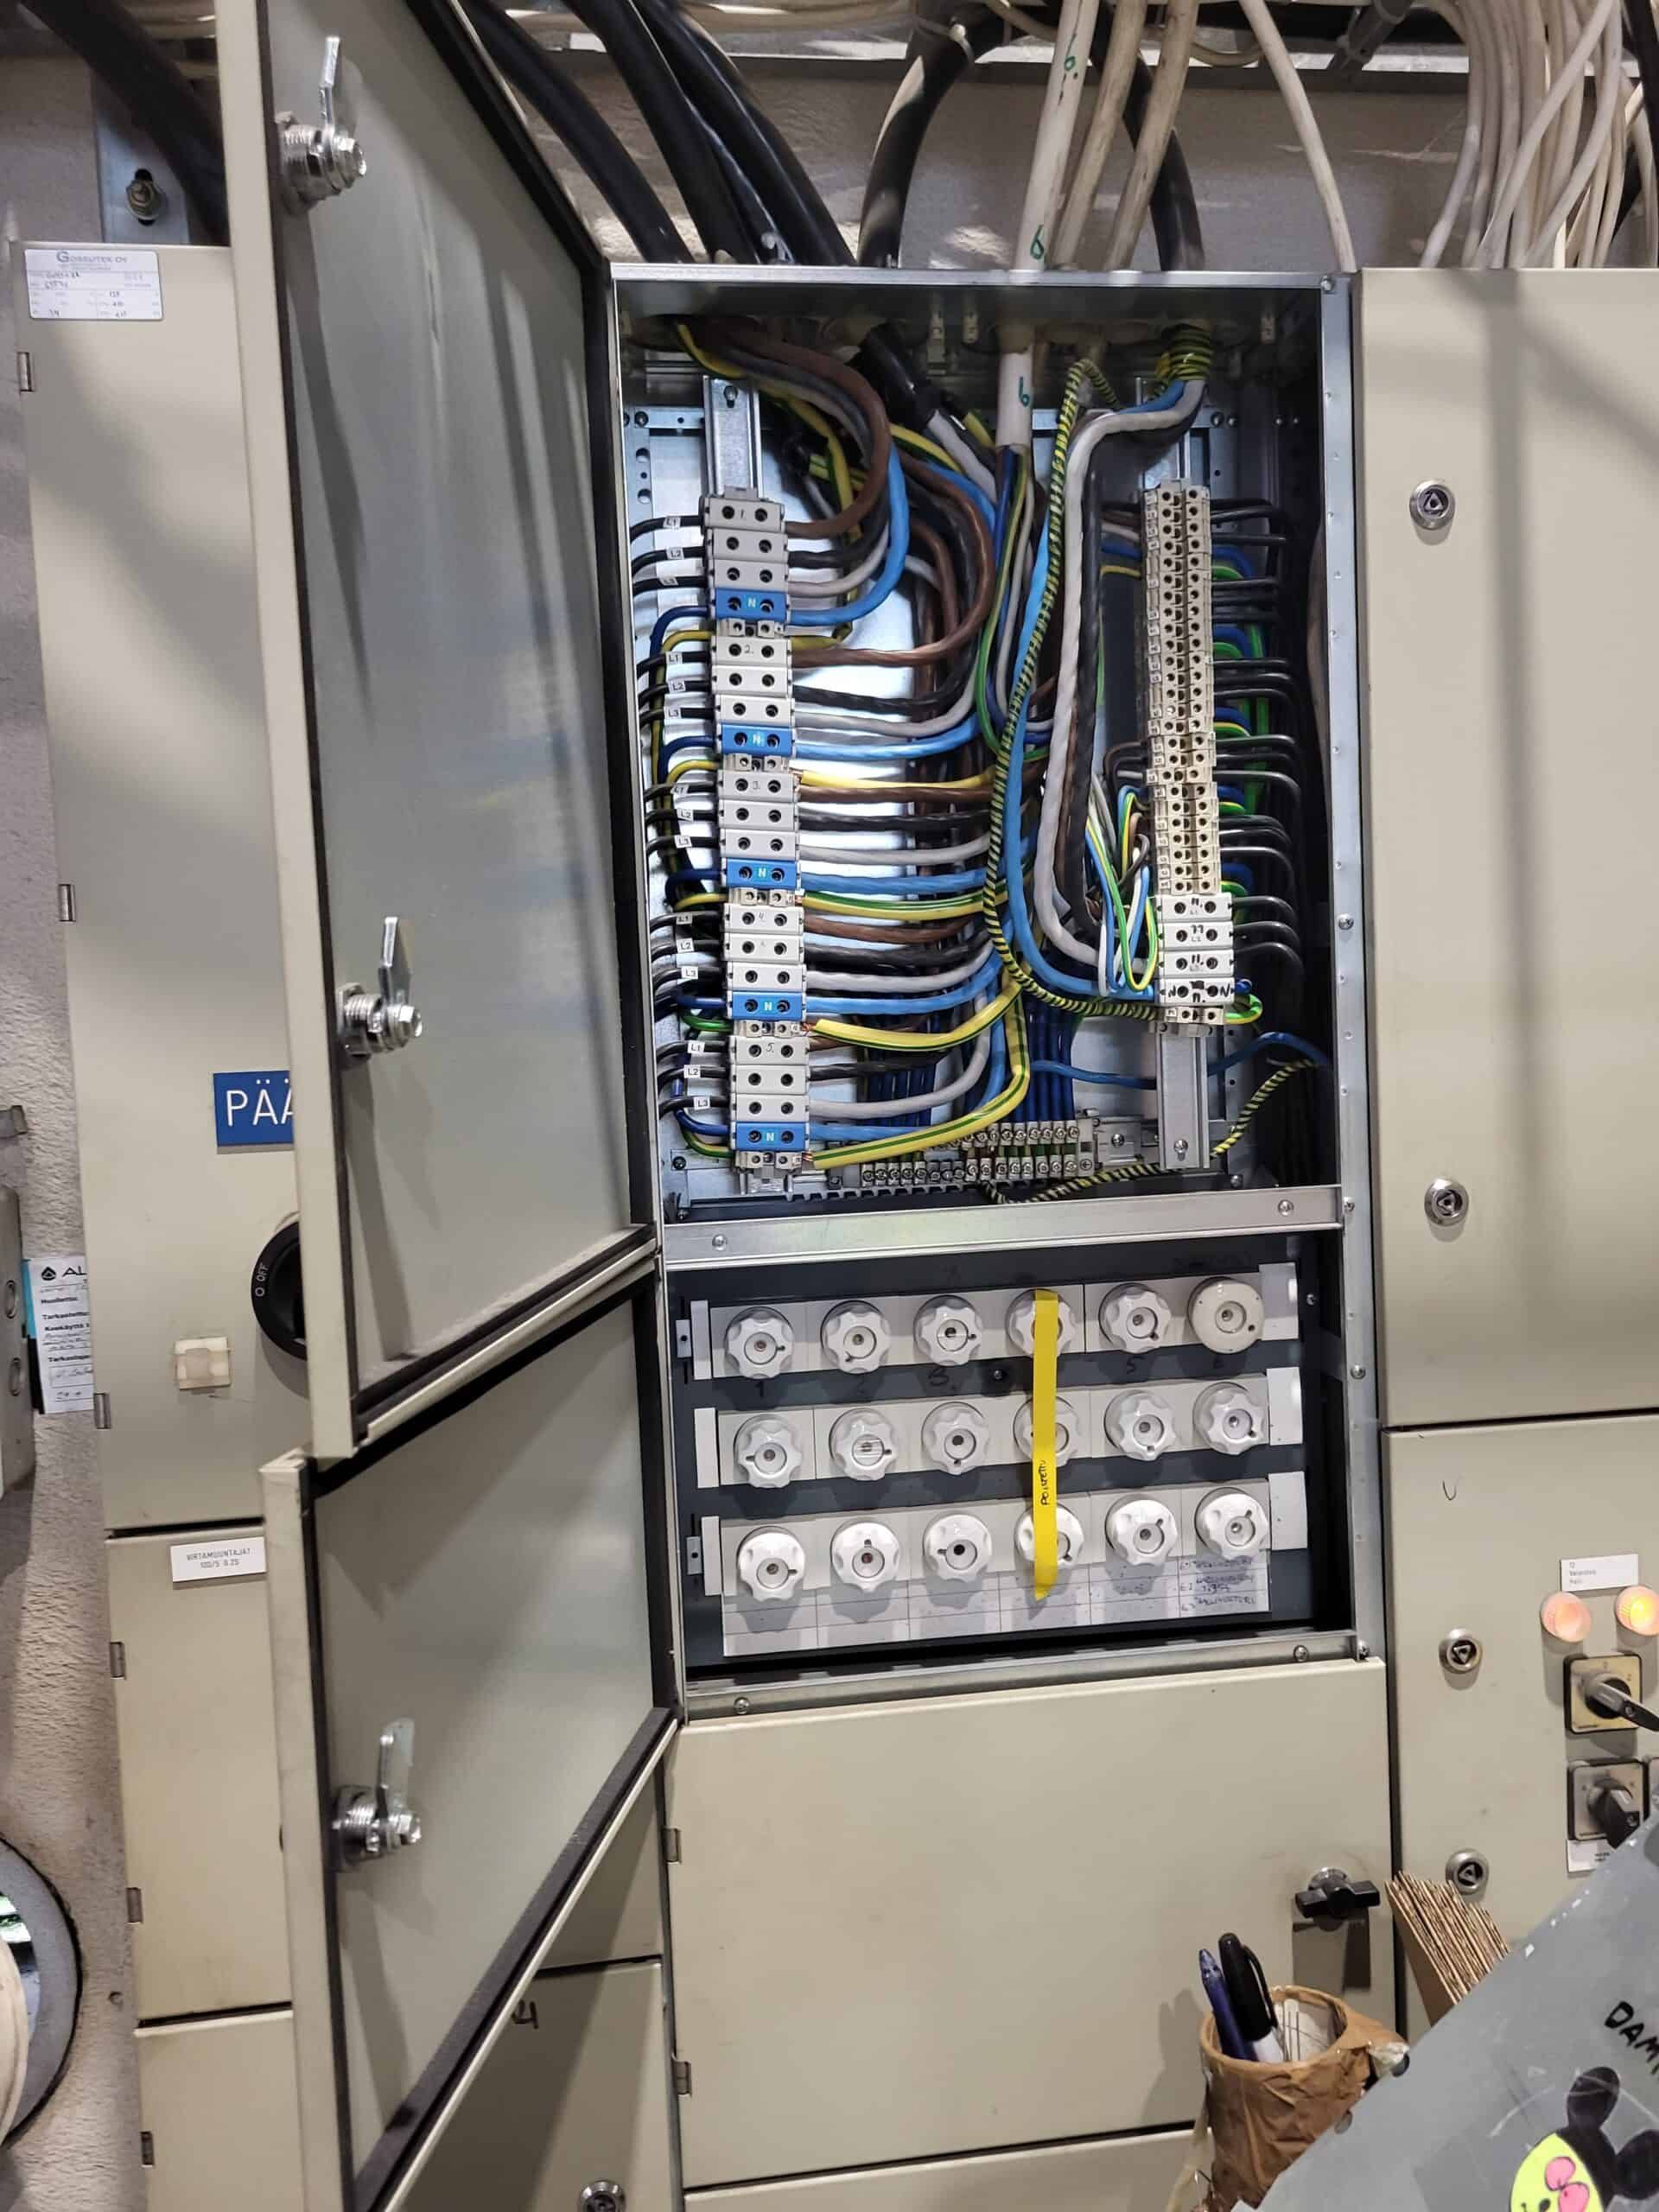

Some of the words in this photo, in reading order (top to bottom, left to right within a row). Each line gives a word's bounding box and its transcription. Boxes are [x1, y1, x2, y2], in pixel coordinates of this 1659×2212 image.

[1029, 224, 1044, 260] 6
[1019, 375, 1030, 408] 6
[671, 549, 681, 557] L2
[747, 598, 757, 608] N
[759, 868, 767, 878] N
[1219, 983, 1230, 997] N
[764, 1001, 772, 1011] N
[766, 1133, 775, 1141] N
[256, 1262, 269, 1282] OFF
[1126, 1355, 1145, 1375] 5
[754, 1382, 765, 1398] 1
